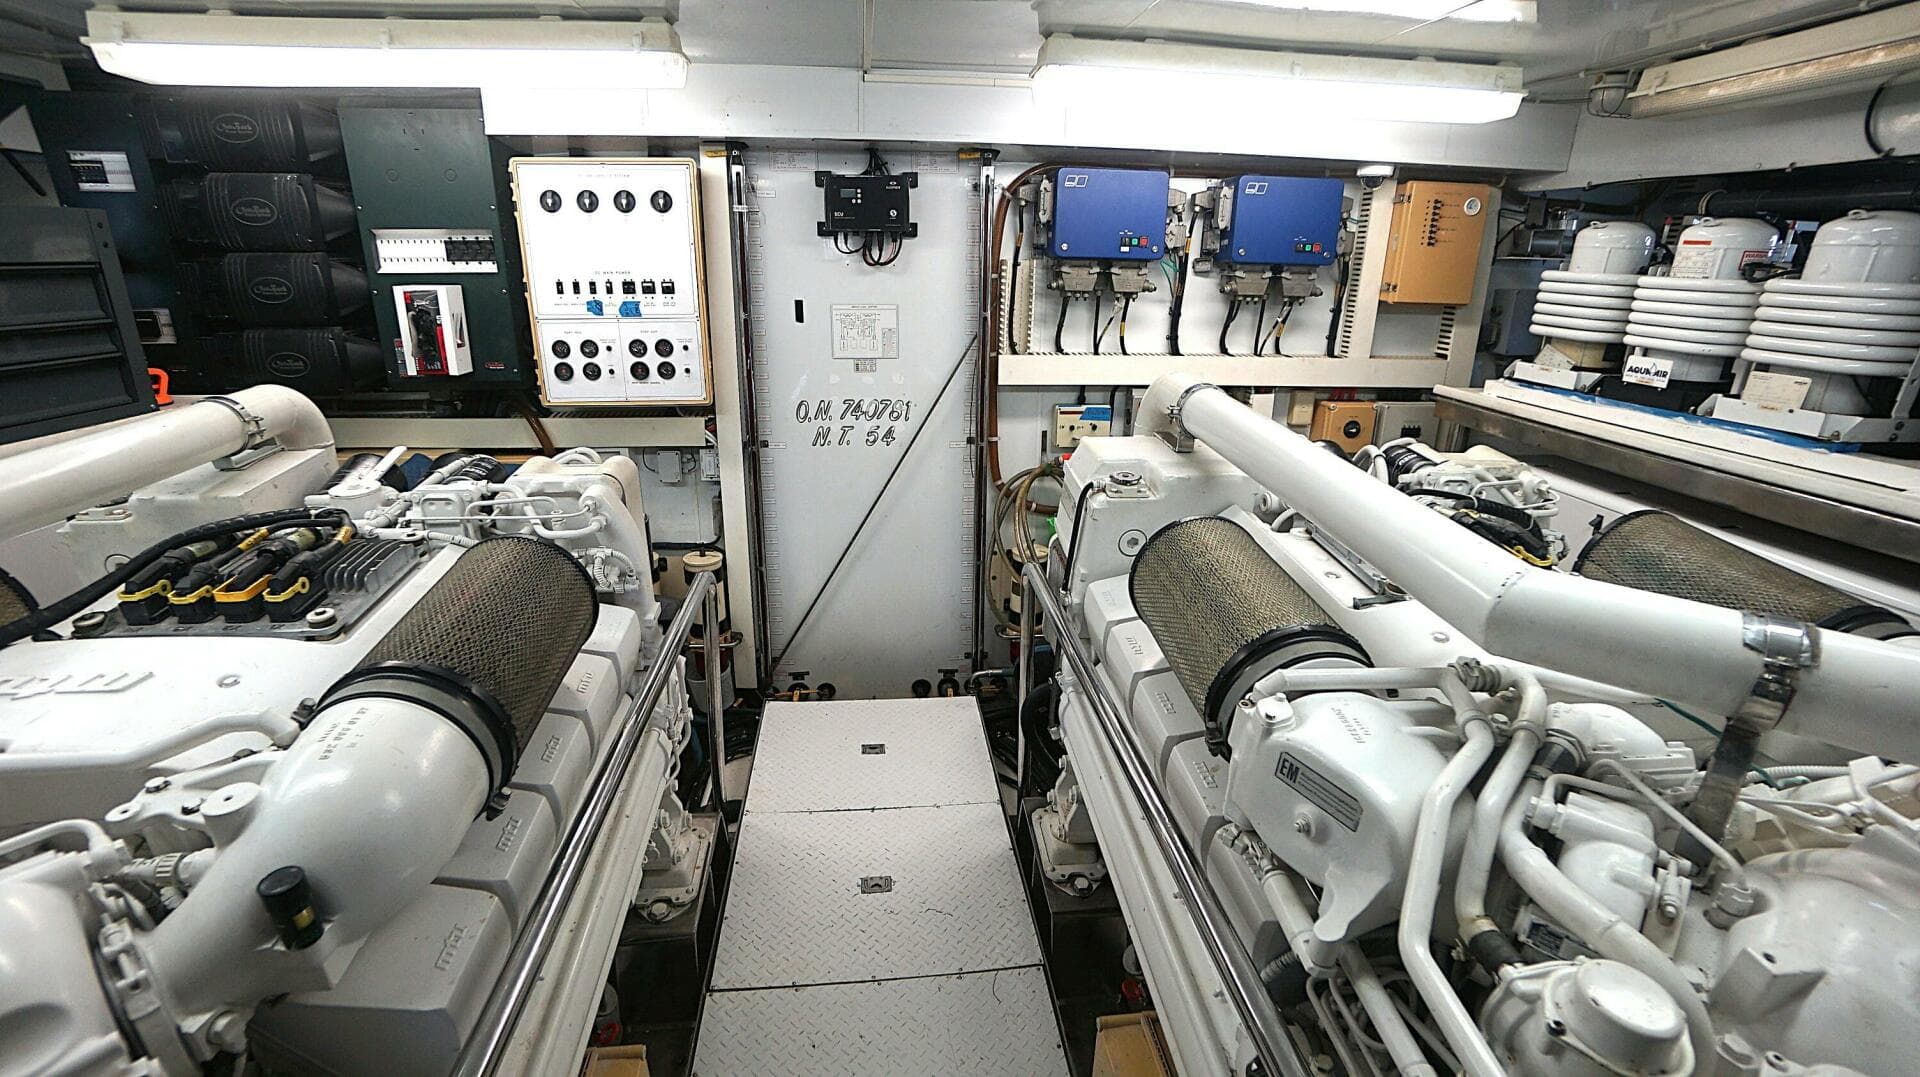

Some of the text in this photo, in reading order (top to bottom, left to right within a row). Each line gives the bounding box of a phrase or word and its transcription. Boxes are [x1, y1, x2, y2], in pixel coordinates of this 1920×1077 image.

[1627, 365, 1669, 378] AQUA AIR
[796, 399, 833, 423] O.N.
[865, 425, 896, 447] 54
[1279, 757, 1300, 783] EM
